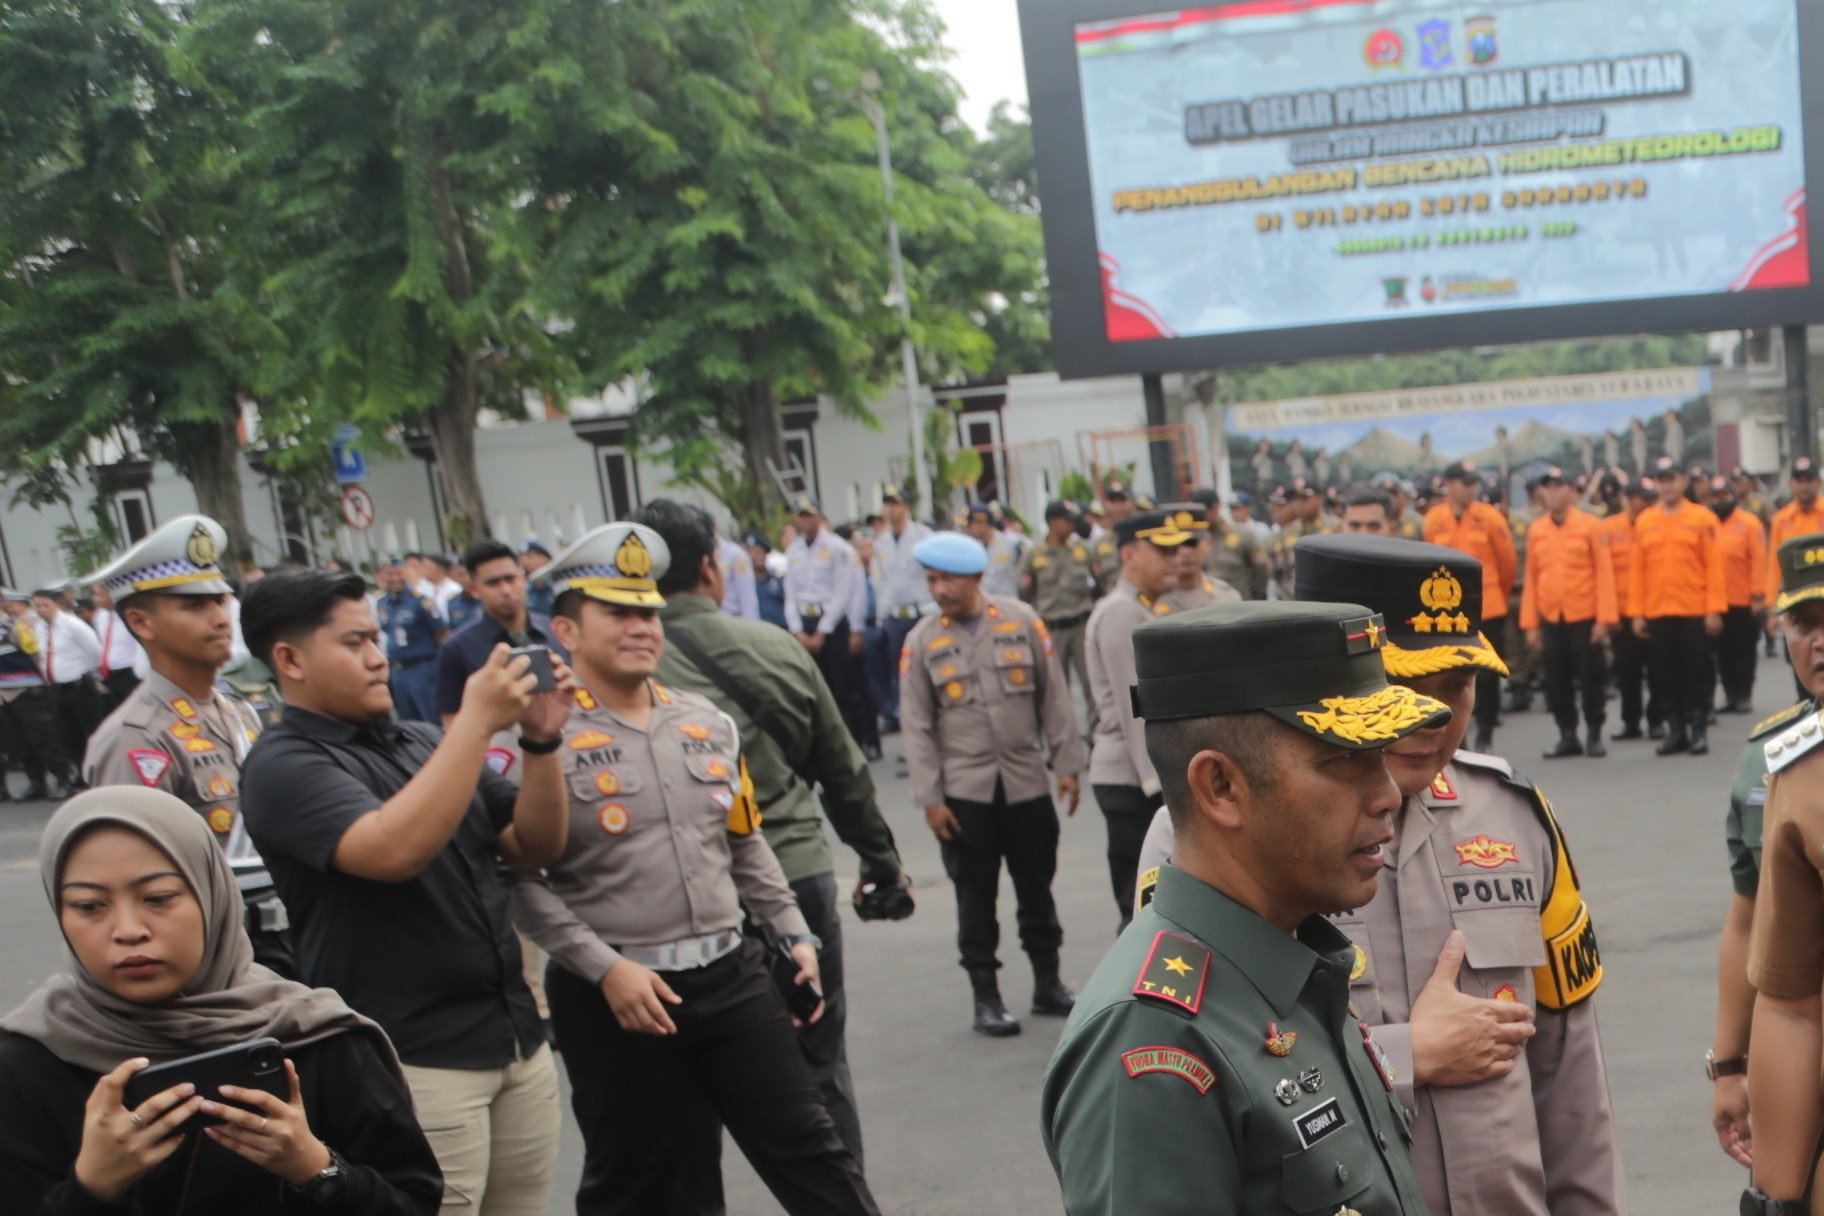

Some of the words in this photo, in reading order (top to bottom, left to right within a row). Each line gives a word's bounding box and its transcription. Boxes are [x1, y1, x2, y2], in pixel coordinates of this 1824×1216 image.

[1250, 91, 1334, 135] GELAR
[1335, 76, 1464, 127] PASUKAN
[1467, 70, 1527, 111] DAN
[1529, 54, 1687, 104] PERALATAN
[1113, 168, 1357, 213] PENANGGULANGAN
[1363, 155, 1490, 188] BENCANA
[1498, 126, 1782, 174] HIDROMETEOROLOGI
[1453, 877, 1535, 905] POLRI
